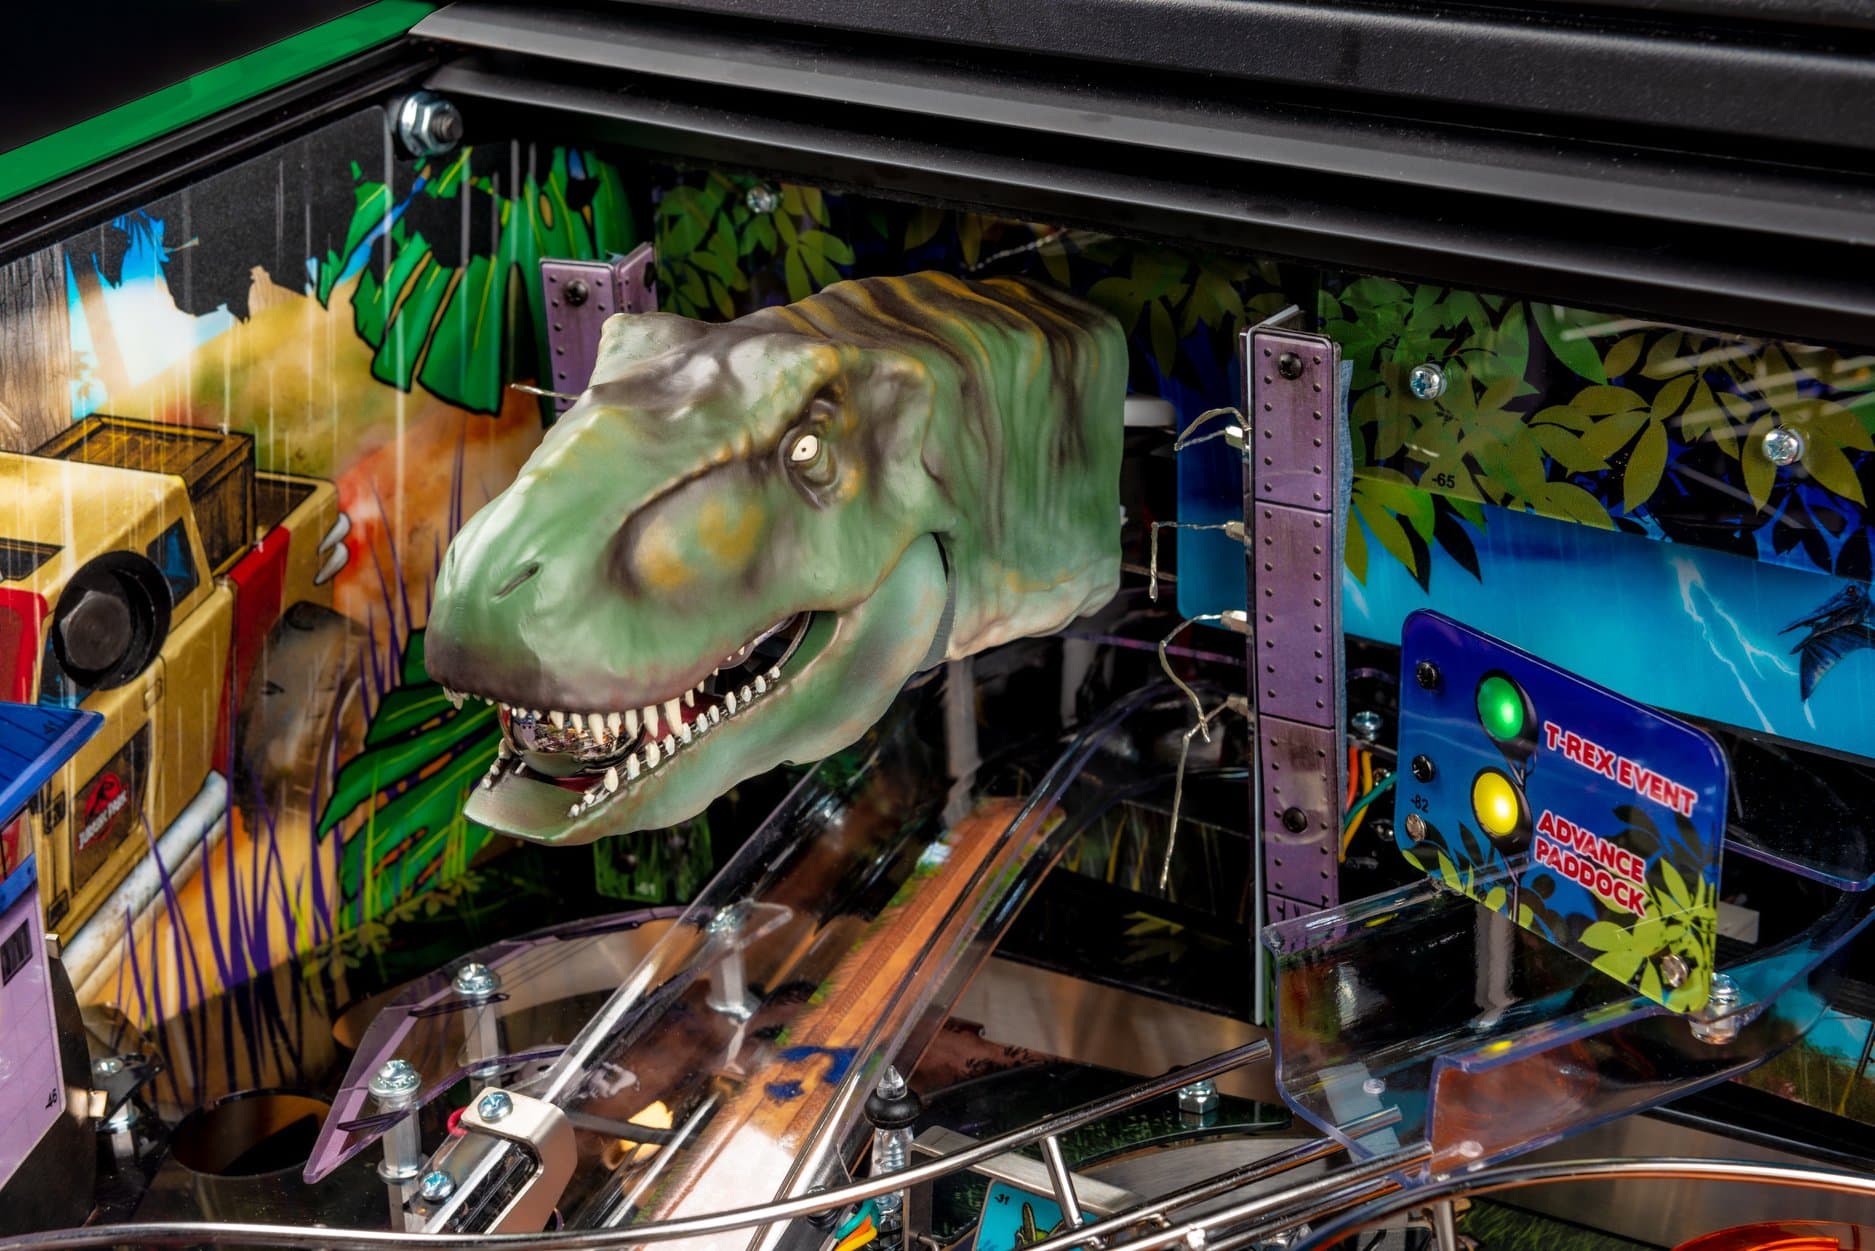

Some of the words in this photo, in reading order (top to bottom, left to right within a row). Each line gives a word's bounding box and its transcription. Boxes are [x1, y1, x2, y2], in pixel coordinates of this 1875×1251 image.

[1432, 473, 1455, 488] -65
[1544, 721, 1616, 780] T-REX
[1616, 756, 1698, 817] EVENT
[1535, 836, 1647, 918] PADDOCK
[1536, 809, 1646, 884] ADVANCE
